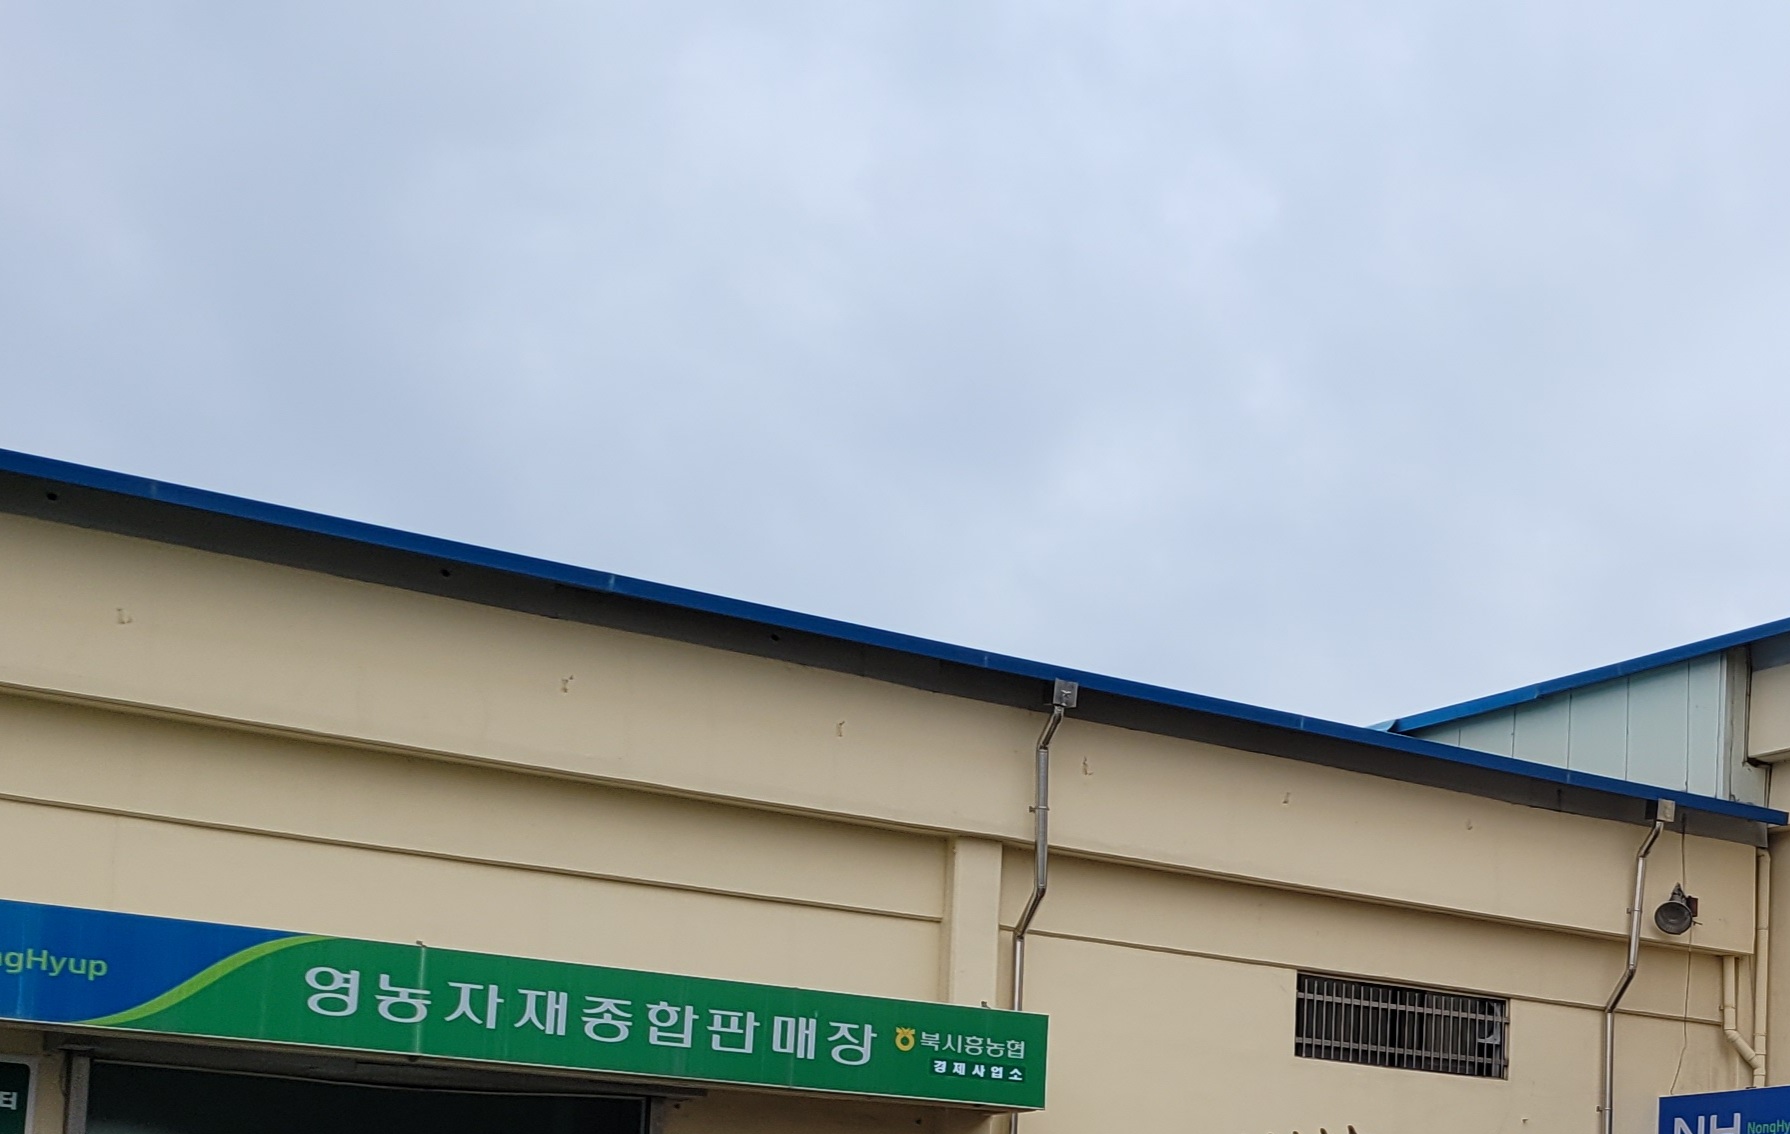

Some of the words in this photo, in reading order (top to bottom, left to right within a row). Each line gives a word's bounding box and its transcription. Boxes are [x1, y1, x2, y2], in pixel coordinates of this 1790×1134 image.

[0, 948, 108, 981] gHyup
[304, 965, 877, 1067] 영농자재종합판매장
[920, 1030, 1025, 1060] 북시흥농협
[933, 1059, 1023, 1082] 경제사업소
